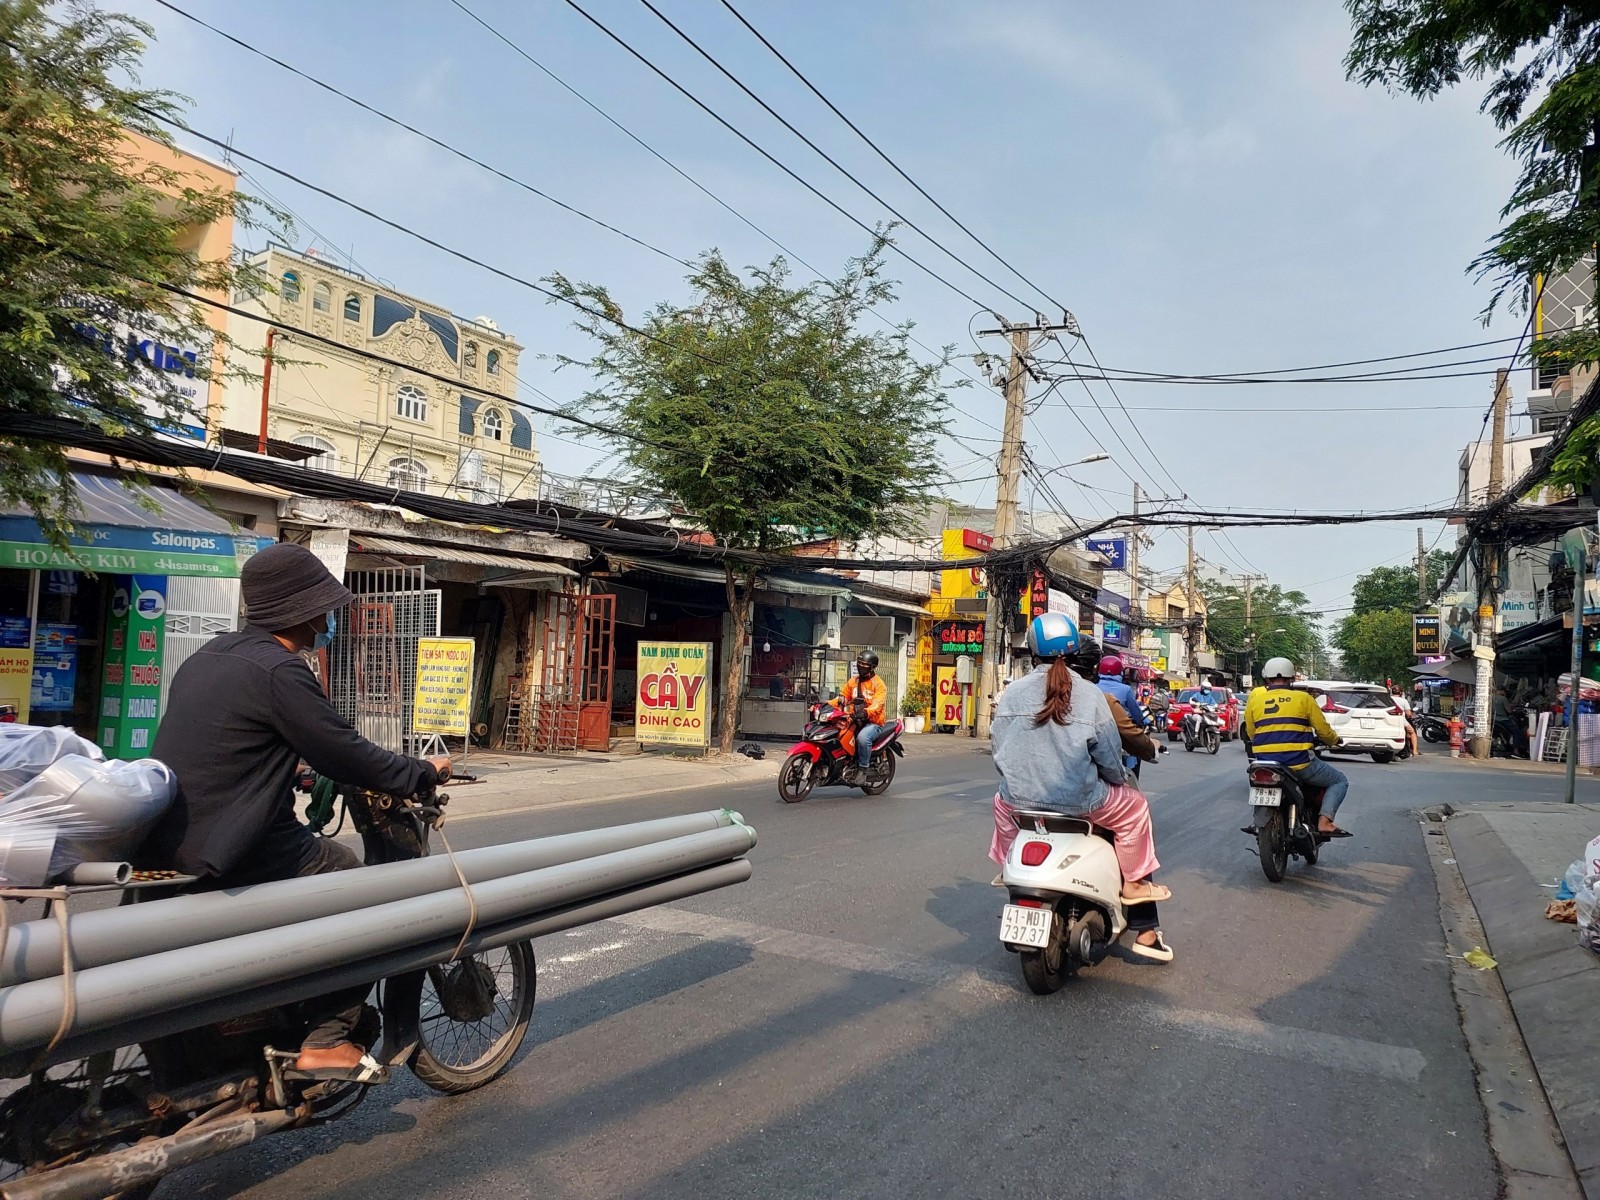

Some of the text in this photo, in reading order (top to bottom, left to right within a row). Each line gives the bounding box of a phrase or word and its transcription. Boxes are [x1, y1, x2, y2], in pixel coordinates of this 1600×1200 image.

[152, 531, 216, 550] Salonpas
[1097, 541, 1115, 551] NHÀ
[98, 553, 137, 569] KIM
[1502, 601, 1525, 611] Minh
[138, 625, 157, 652] NHÀ
[1419, 628, 1436, 636] MINH
[641, 646, 704, 659] NAM ĐỊNH QUÁN
[16, 659, 29, 667] HO
[130, 657, 160, 686] THUỐC
[640, 662, 705, 712] CẦY
[128, 695, 157, 718] HOÀNG
[639, 711, 701, 728] ĐỈNH CAO
[1004, 924, 1045, 943] 737.37
